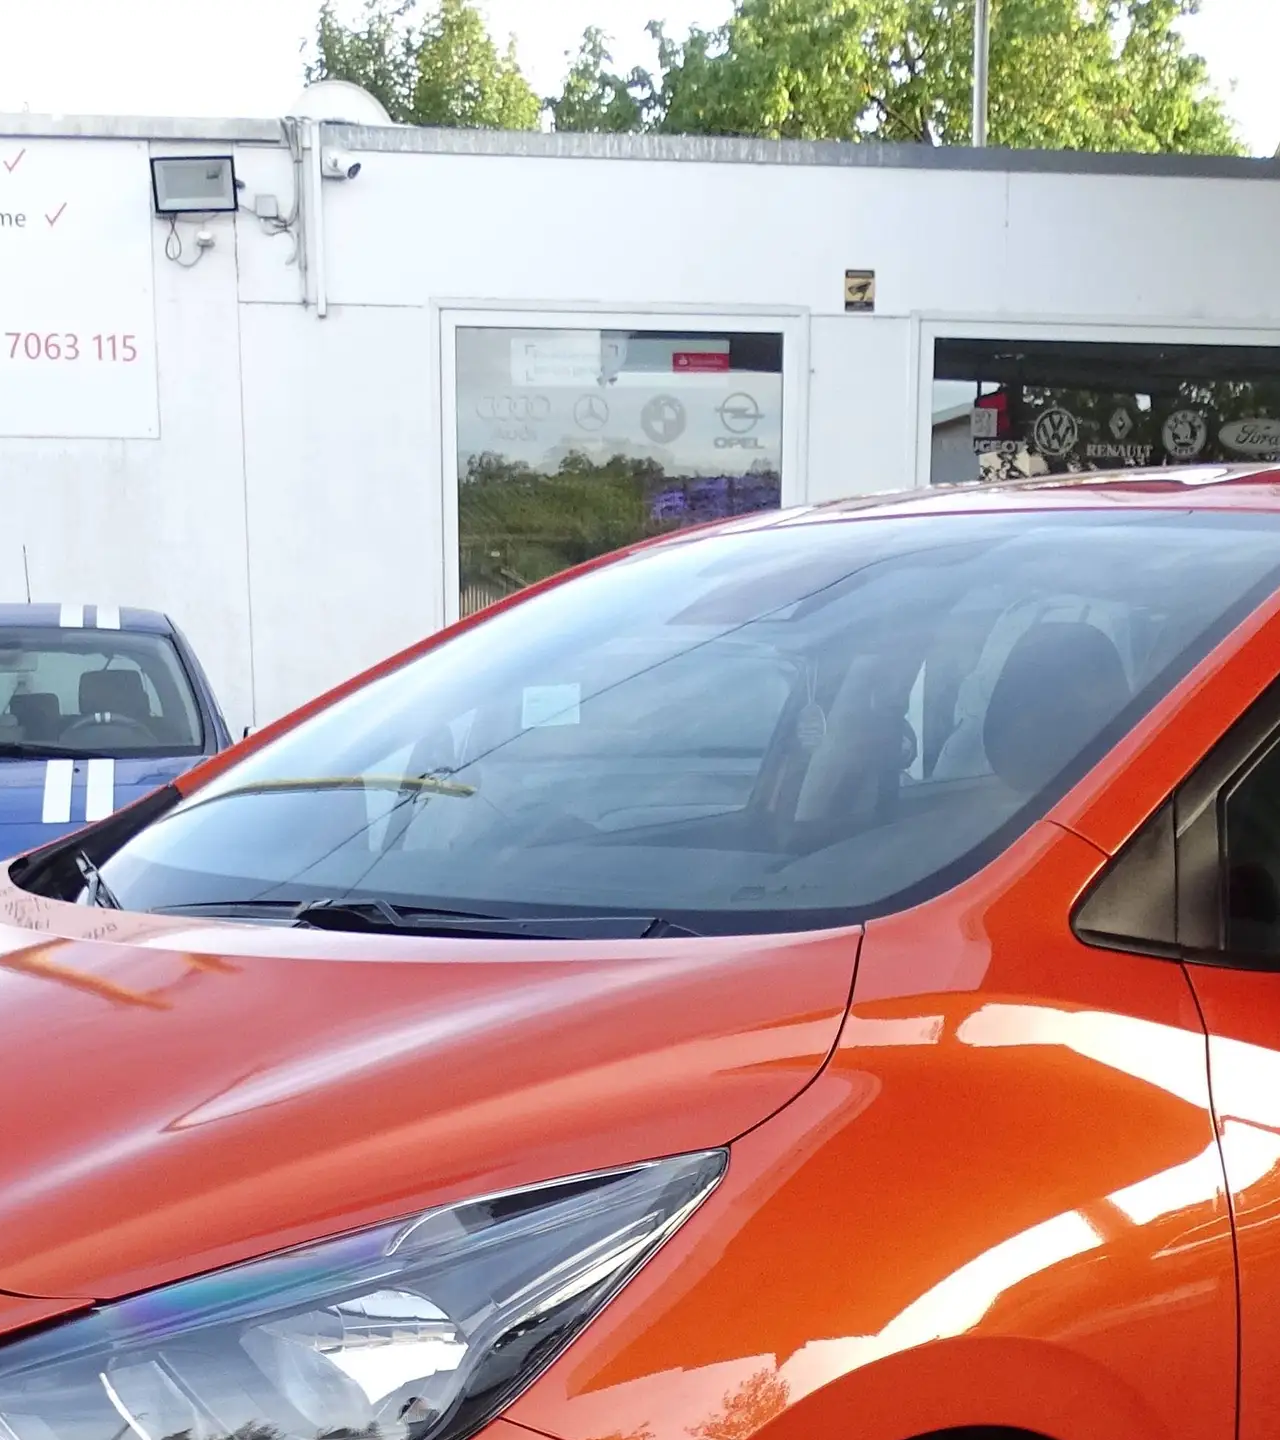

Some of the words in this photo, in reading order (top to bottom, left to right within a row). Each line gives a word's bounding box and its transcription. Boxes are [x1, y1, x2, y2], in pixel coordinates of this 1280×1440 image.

[5, 332, 80, 360] 7063
[93, 334, 138, 362] 115
[713, 437, 766, 450] OPEL
[1086, 443, 1153, 457] RENAULT
